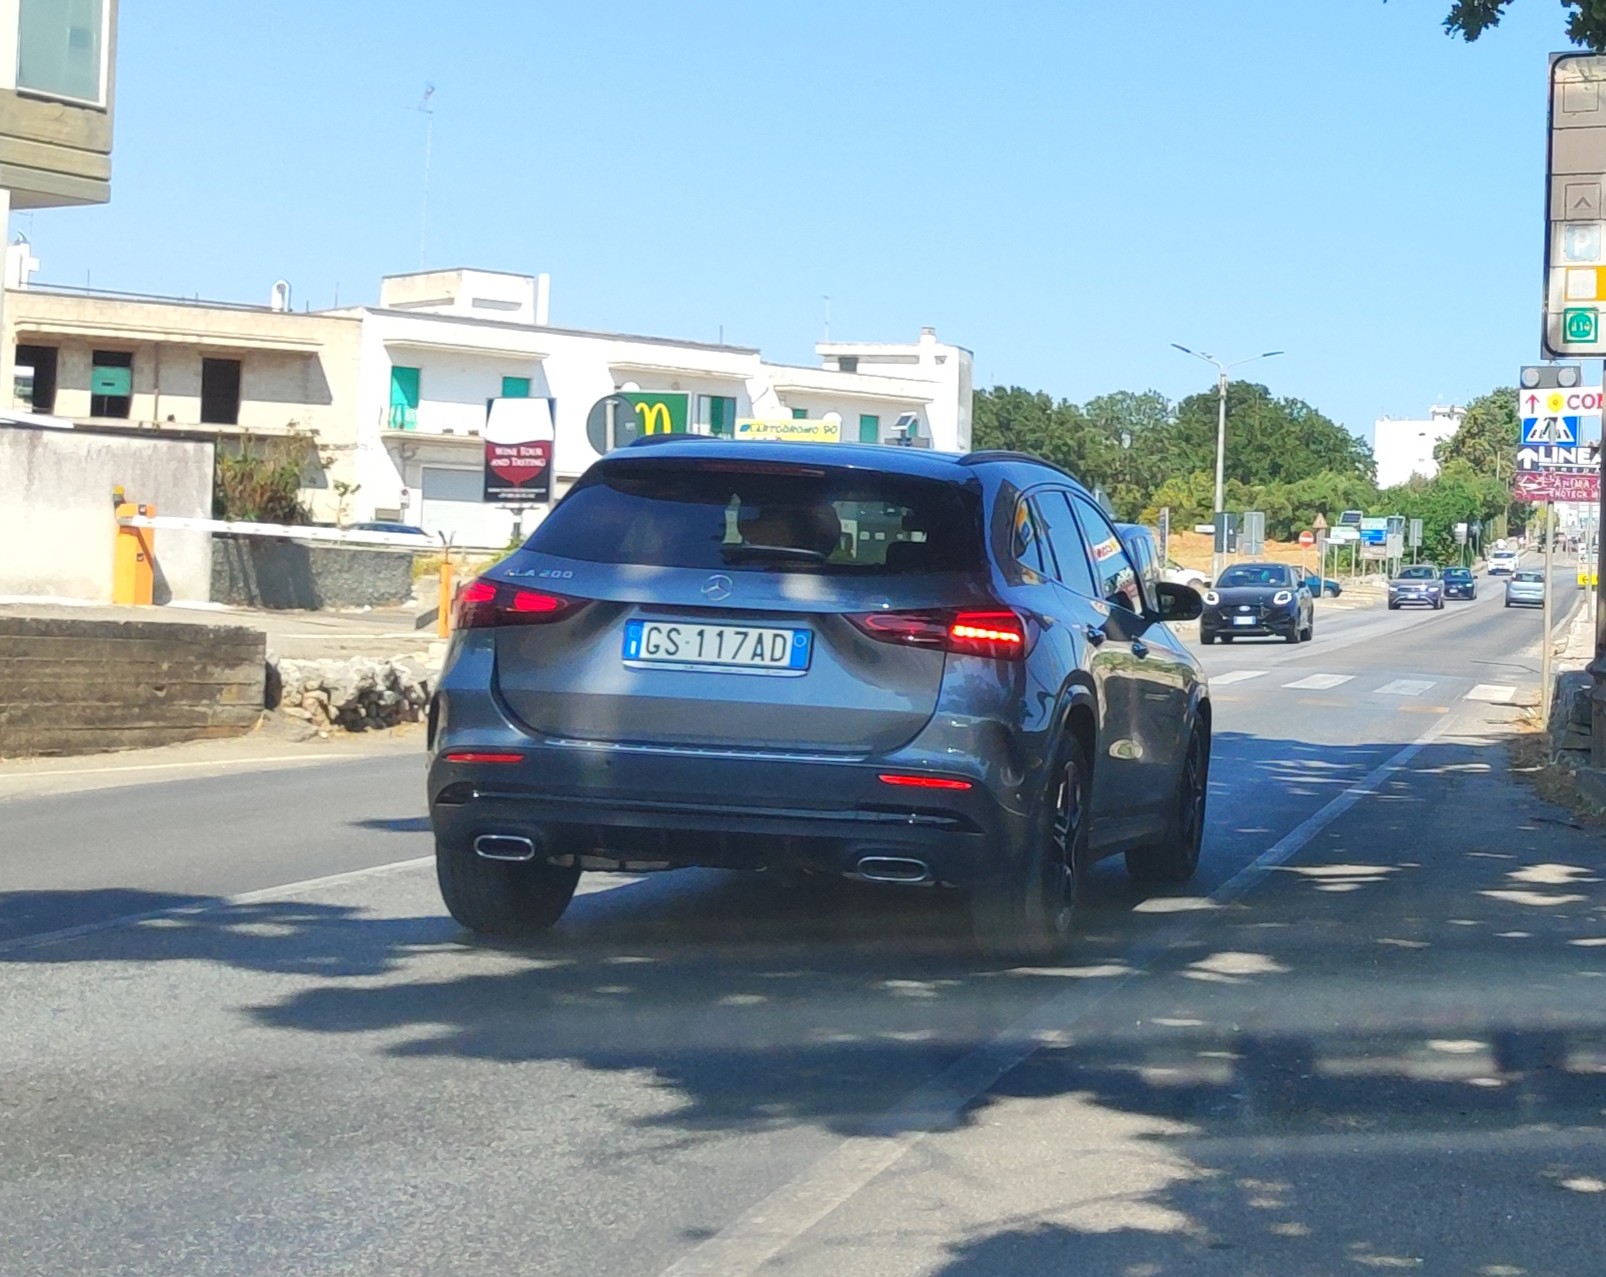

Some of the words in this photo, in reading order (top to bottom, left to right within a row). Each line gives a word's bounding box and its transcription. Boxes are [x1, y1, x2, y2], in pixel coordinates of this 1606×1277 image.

[520, 446, 543, 456] TOUR
[490, 458, 510, 467] AND
[510, 457, 546, 467] TASTING
[1549, 488, 1587, 497] ENOTECA
[539, 569, 573, 579] 200
